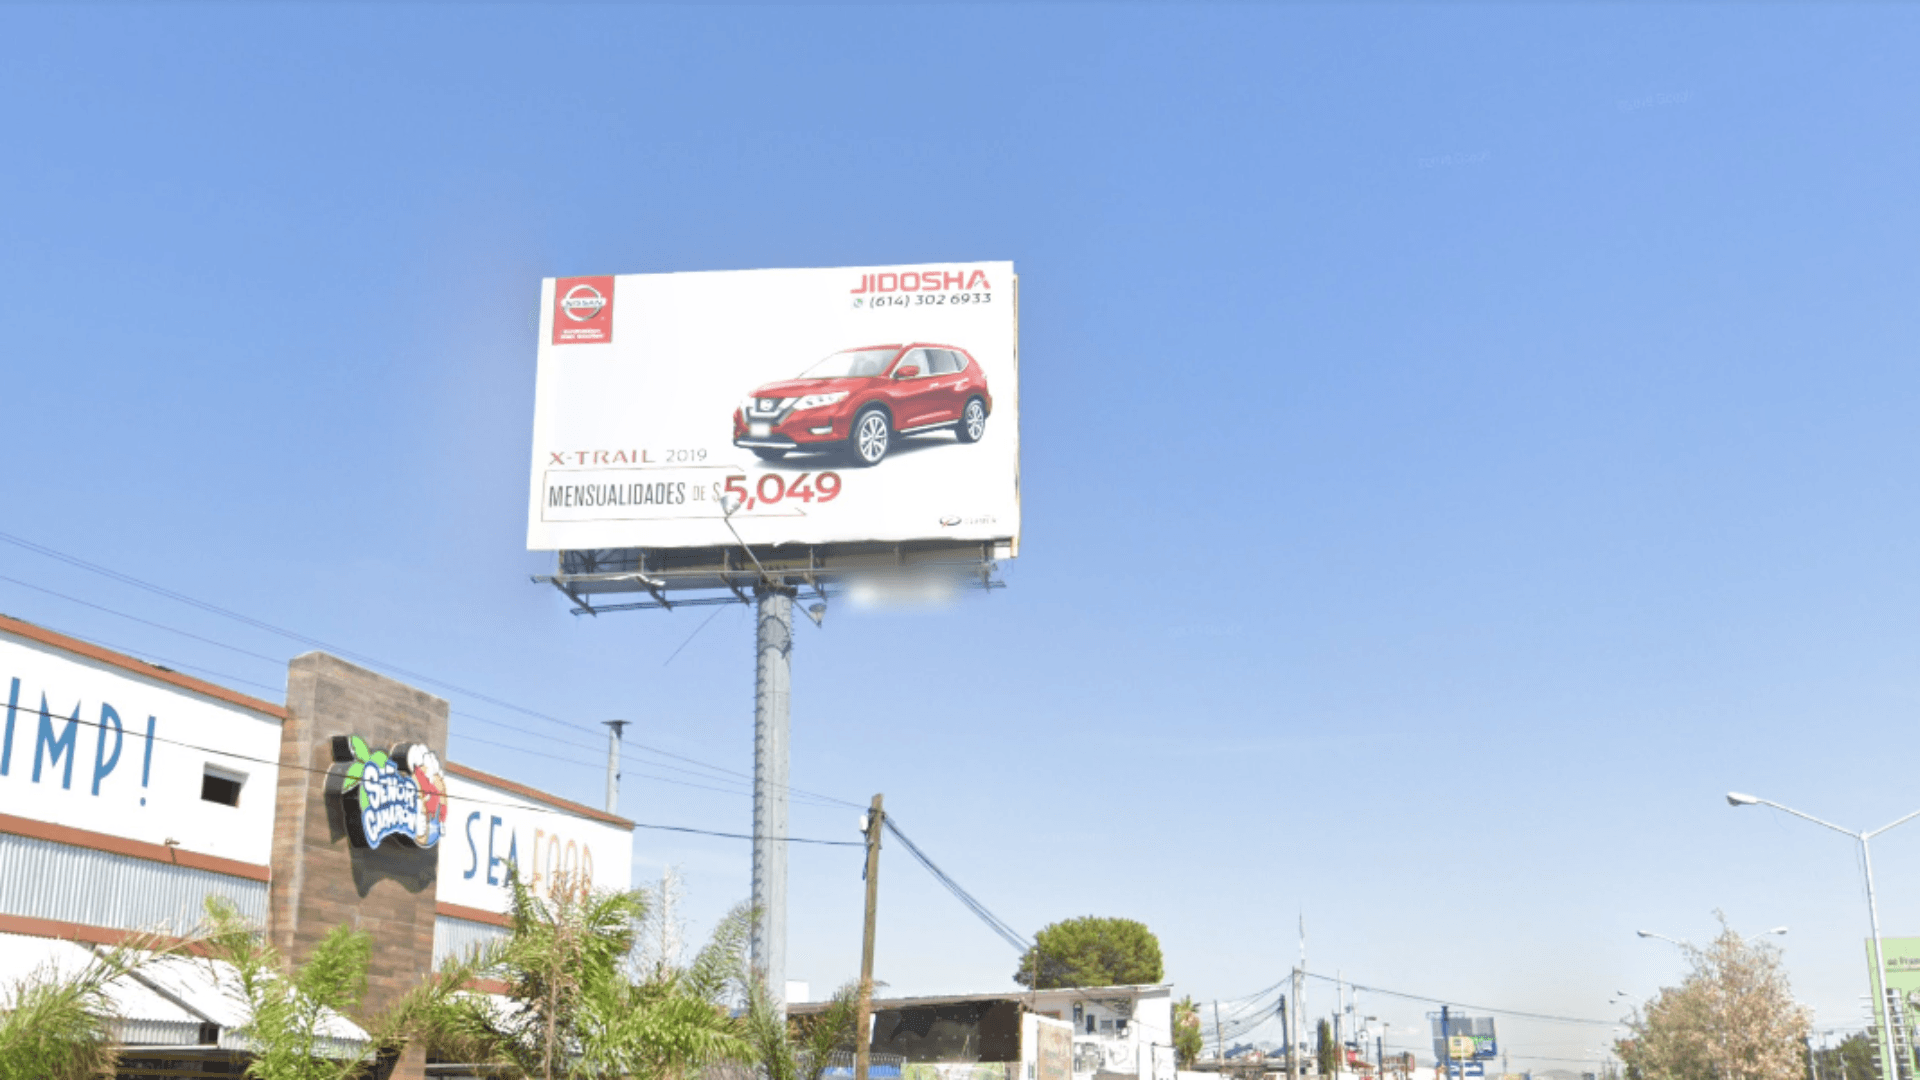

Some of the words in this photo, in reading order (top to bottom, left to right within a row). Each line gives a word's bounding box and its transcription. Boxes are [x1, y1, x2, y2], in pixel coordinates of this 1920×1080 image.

[850, 269, 991, 294] JIDOSHA
[869, 294, 910, 309] (614)
[914, 294, 946, 305] 302
[950, 292, 991, 304] 6933
[549, 449, 656, 466] X-TRAIL
[666, 448, 707, 463] 2019
[549, 481, 686, 508] MENSUALIDADES
[692, 484, 706, 502] DE
